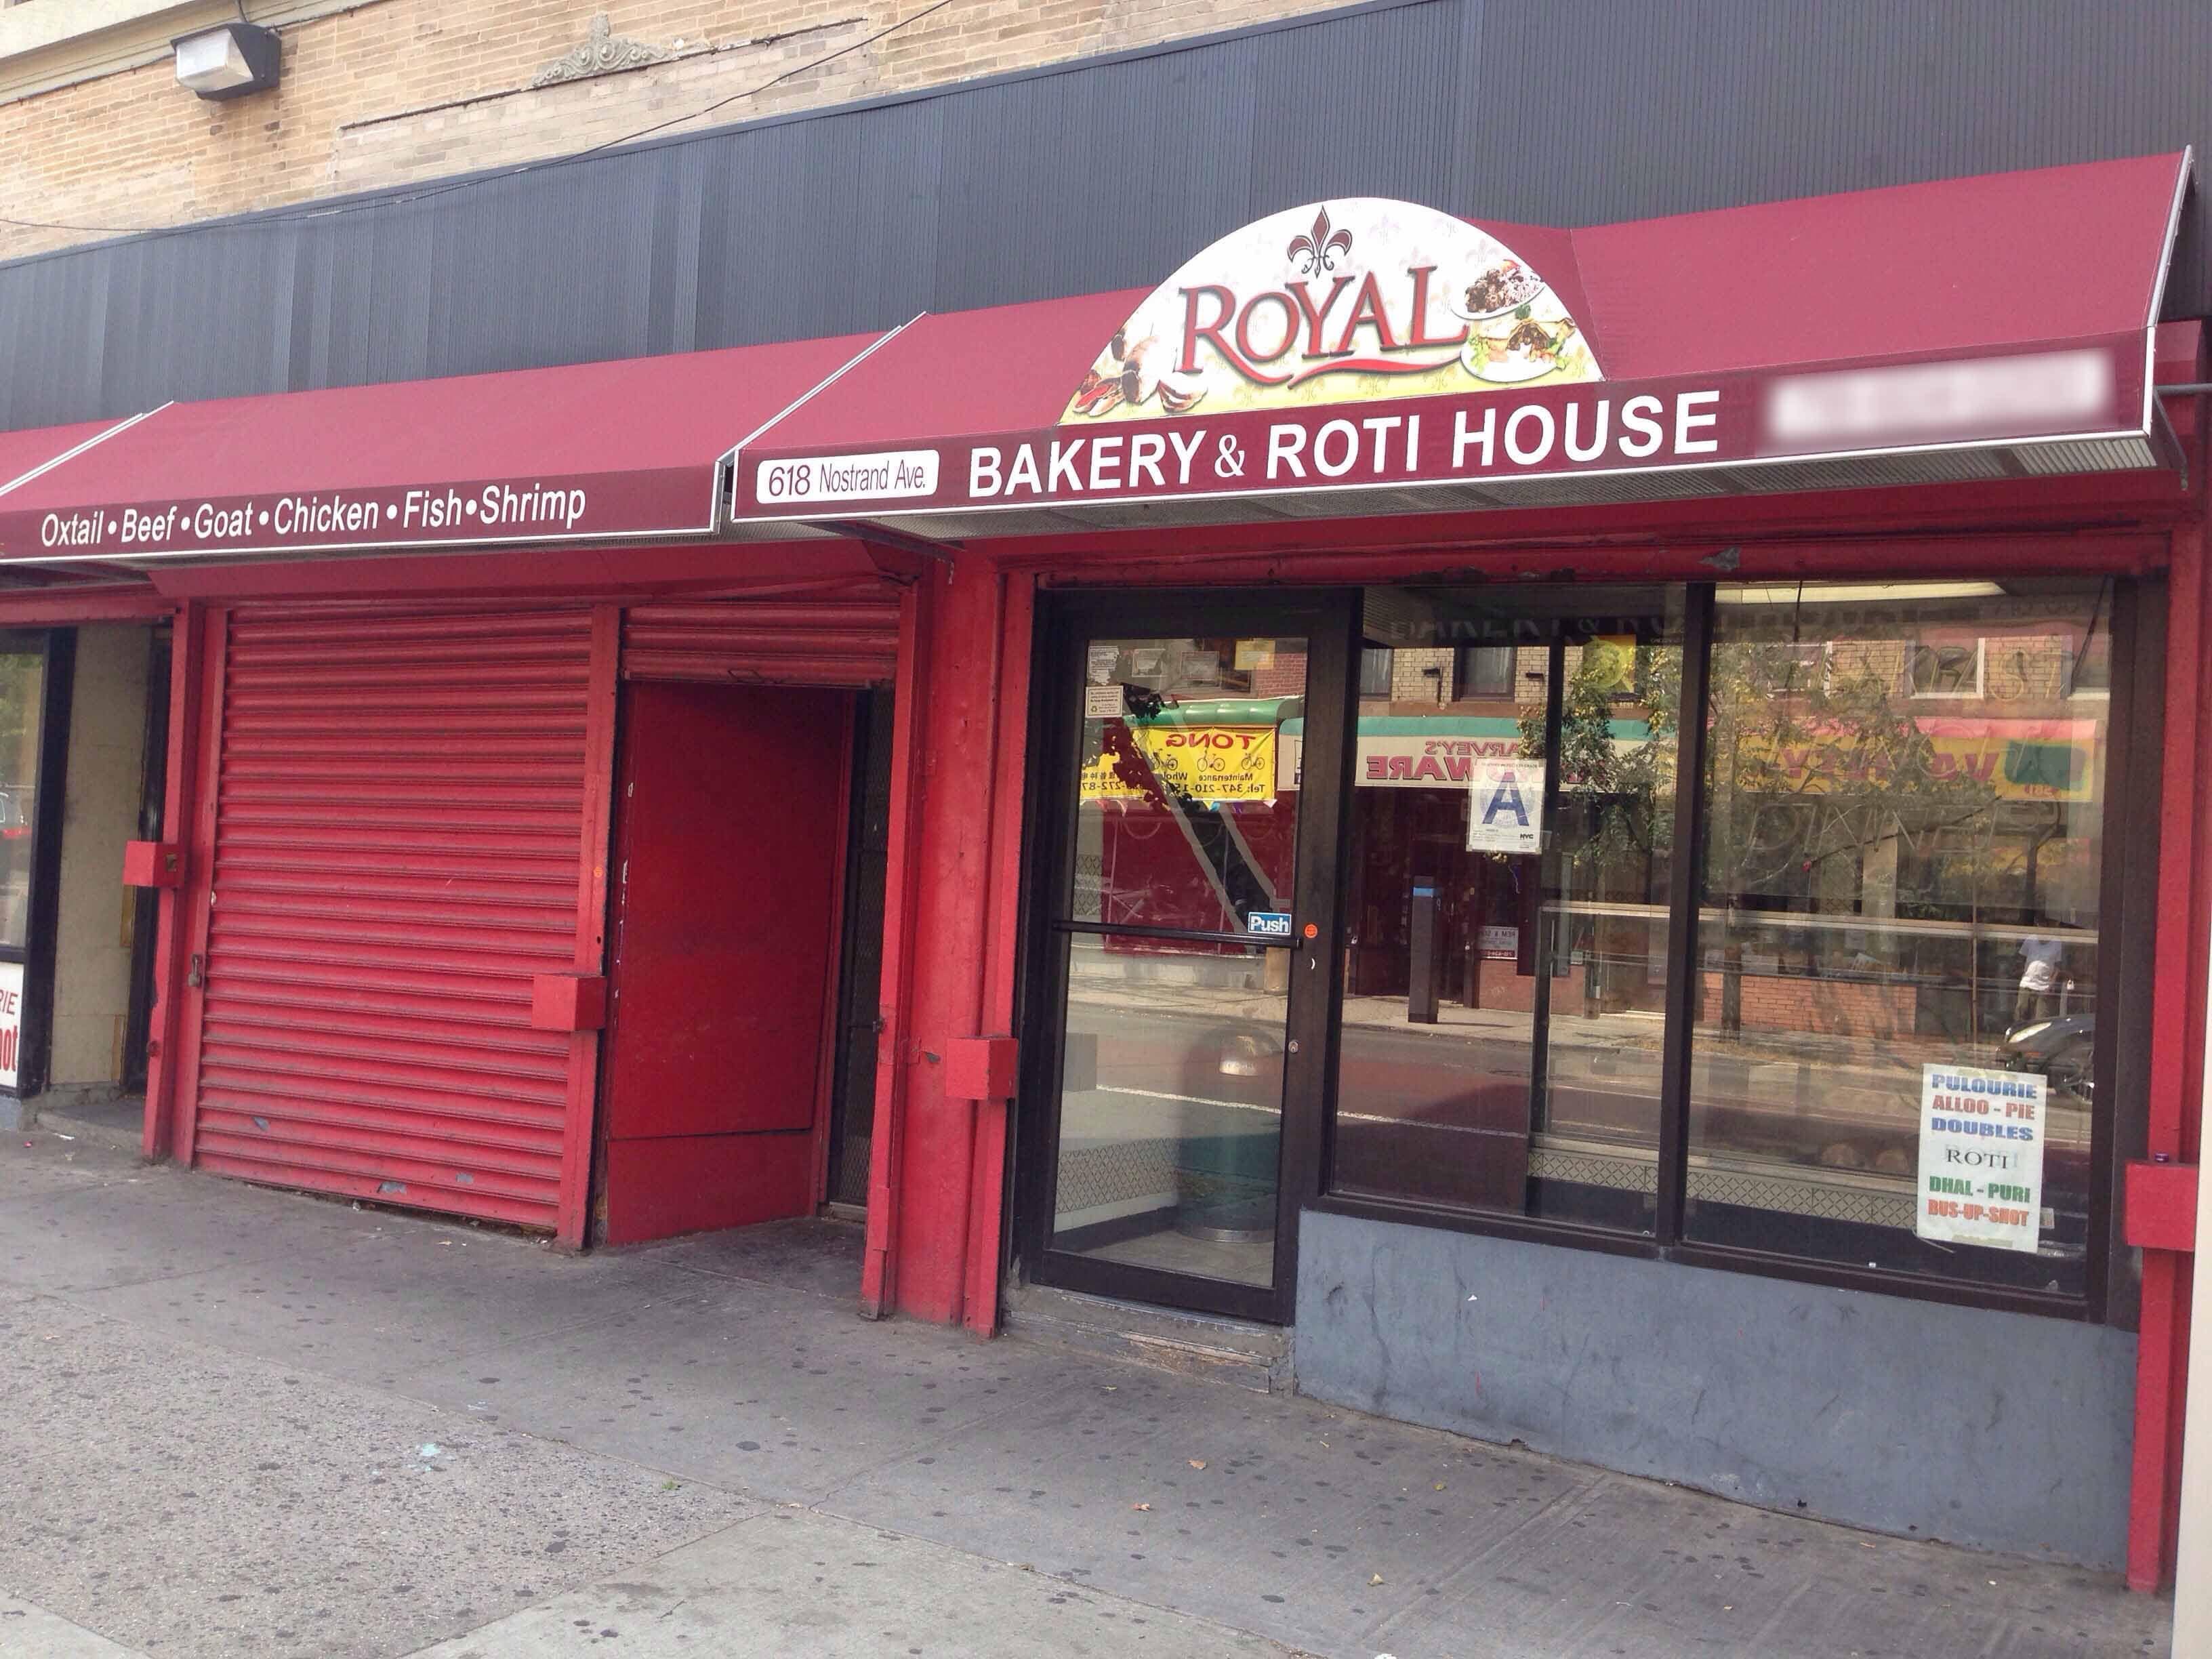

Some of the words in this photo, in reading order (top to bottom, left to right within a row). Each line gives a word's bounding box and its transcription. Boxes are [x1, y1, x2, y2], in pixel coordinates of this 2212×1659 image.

[1173, 265, 1469, 385] ROYAL
[969, 430, 1206, 497] BAKERY
[1214, 434, 1245, 478] &
[1267, 415, 1419, 479] ROTI
[1452, 390, 1721, 468] HOUSE
[768, 464, 811, 497] 618
[819, 460, 888, 493] Nostrand
[895, 459, 926, 491] Ave.
[41, 511, 104, 547] Oxtail
[121, 508, 177, 542] Beef
[194, 504, 253, 538] Goat
[274, 496, 378, 535] Chicken
[404, 489, 462, 529] Fish
[480, 483, 586, 529] Shrimp
[1482, 772, 1530, 826] A
[1250, 916, 1289, 933] Push
[1932, 1073, 2037, 1099] PULOURIE
[1932, 1095, 1989, 1115] ALLOO
[2005, 1103, 2034, 1120] PIE
[1931, 1117, 2033, 1141] DOUBLES
[1946, 1148, 2007, 1169] ROTI
[1929, 1176, 1973, 1196] DHAL
[1988, 1183, 2030, 1203] PURI
[1928, 1199, 2029, 1227] BUS-UP-SHOT
